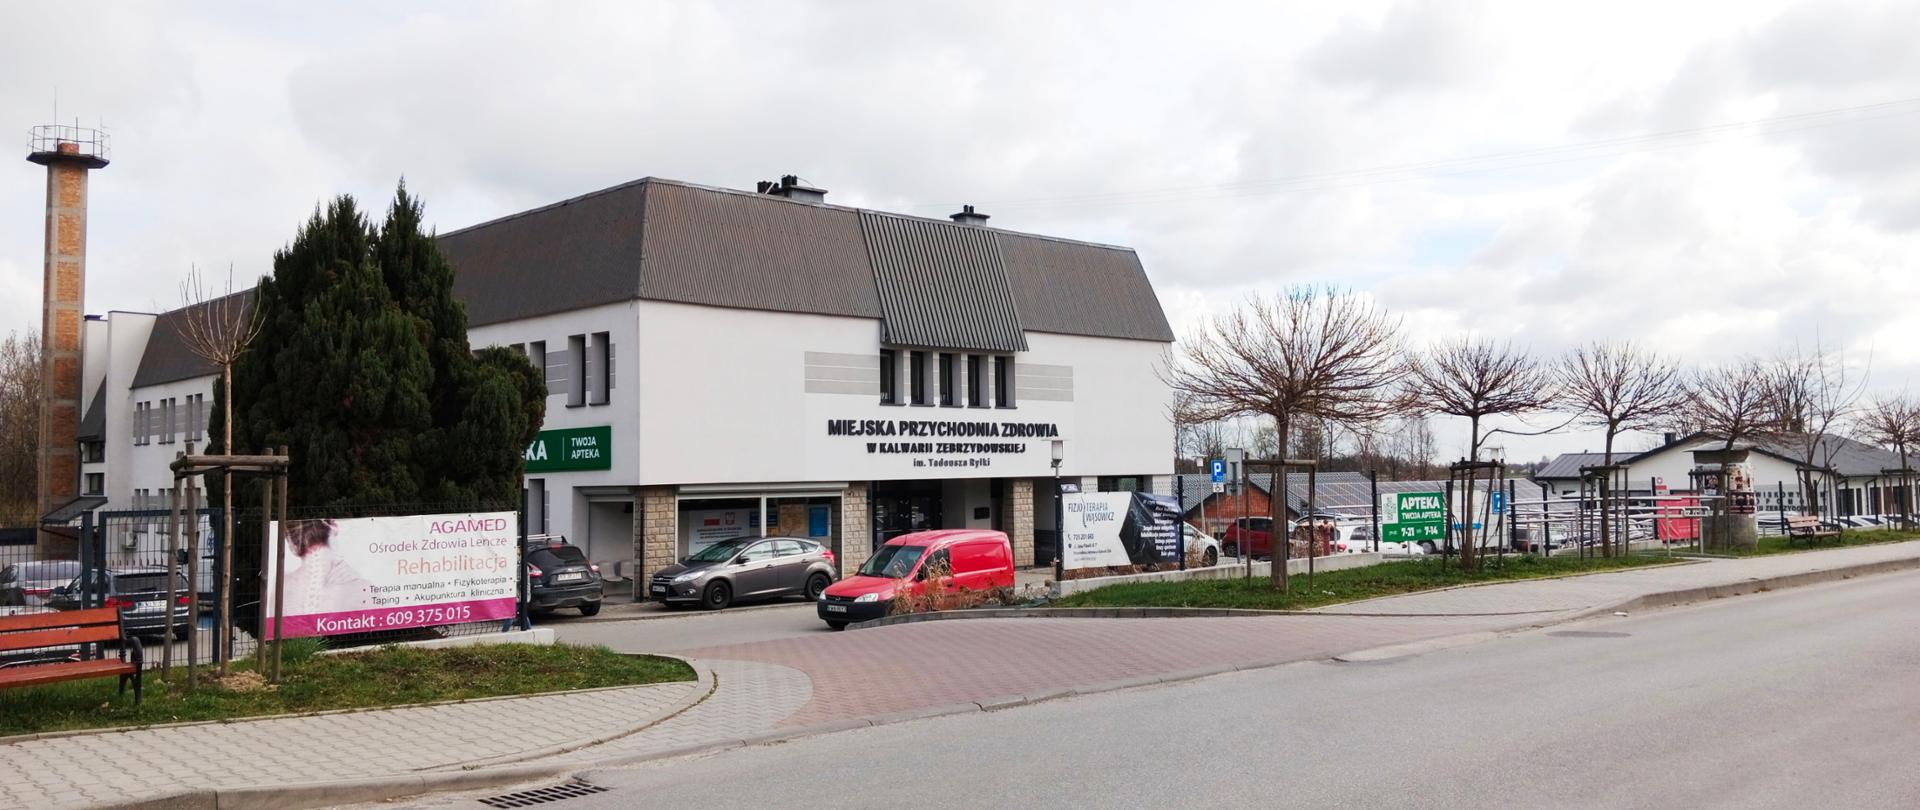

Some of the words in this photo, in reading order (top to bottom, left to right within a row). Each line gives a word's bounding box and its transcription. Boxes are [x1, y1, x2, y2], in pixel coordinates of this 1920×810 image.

[827, 419, 897, 436] MIEJSKA
[899, 420, 1000, 437] PRZYCHODNIA
[1001, 422, 1059, 438] ZDROWIA
[571, 436, 597, 447] TWOJA
[866, 443, 877, 453] W
[879, 443, 933, 453] KALWARII
[936, 443, 1026, 453] ZEBRZYDOWSKIEJ
[571, 448, 600, 460] APTEKA
[913, 458, 927, 467] im.
[928, 458, 968, 467] Tadeusza
[1214, 462, 1221, 476] P
[1400, 496, 1440, 510] APTEKA
[1401, 512, 1420, 520] TWOJA
[1422, 510, 1442, 519] APTEKA
[429, 518, 507, 534] AGAMED
[369, 541, 419, 554] Ośrodek
[421, 538, 468, 551] Zdrowia
[471, 536, 507, 548] Lencze
[398, 555, 508, 576] Rehabilitacja
[370, 584, 401, 595] Terapia
[403, 582, 446, 592] manualna
[454, 576, 507, 588] Fizykoterapia
[372, 596, 400, 606] Taping
[414, 590, 466, 602] Akupunktura
[471, 588, 505, 597] kliniczna
[316, 618, 375, 632] Kontakt
[386, 612, 413, 626] 609
[418, 609, 443, 623] 375
[446, 606, 471, 620] 015
